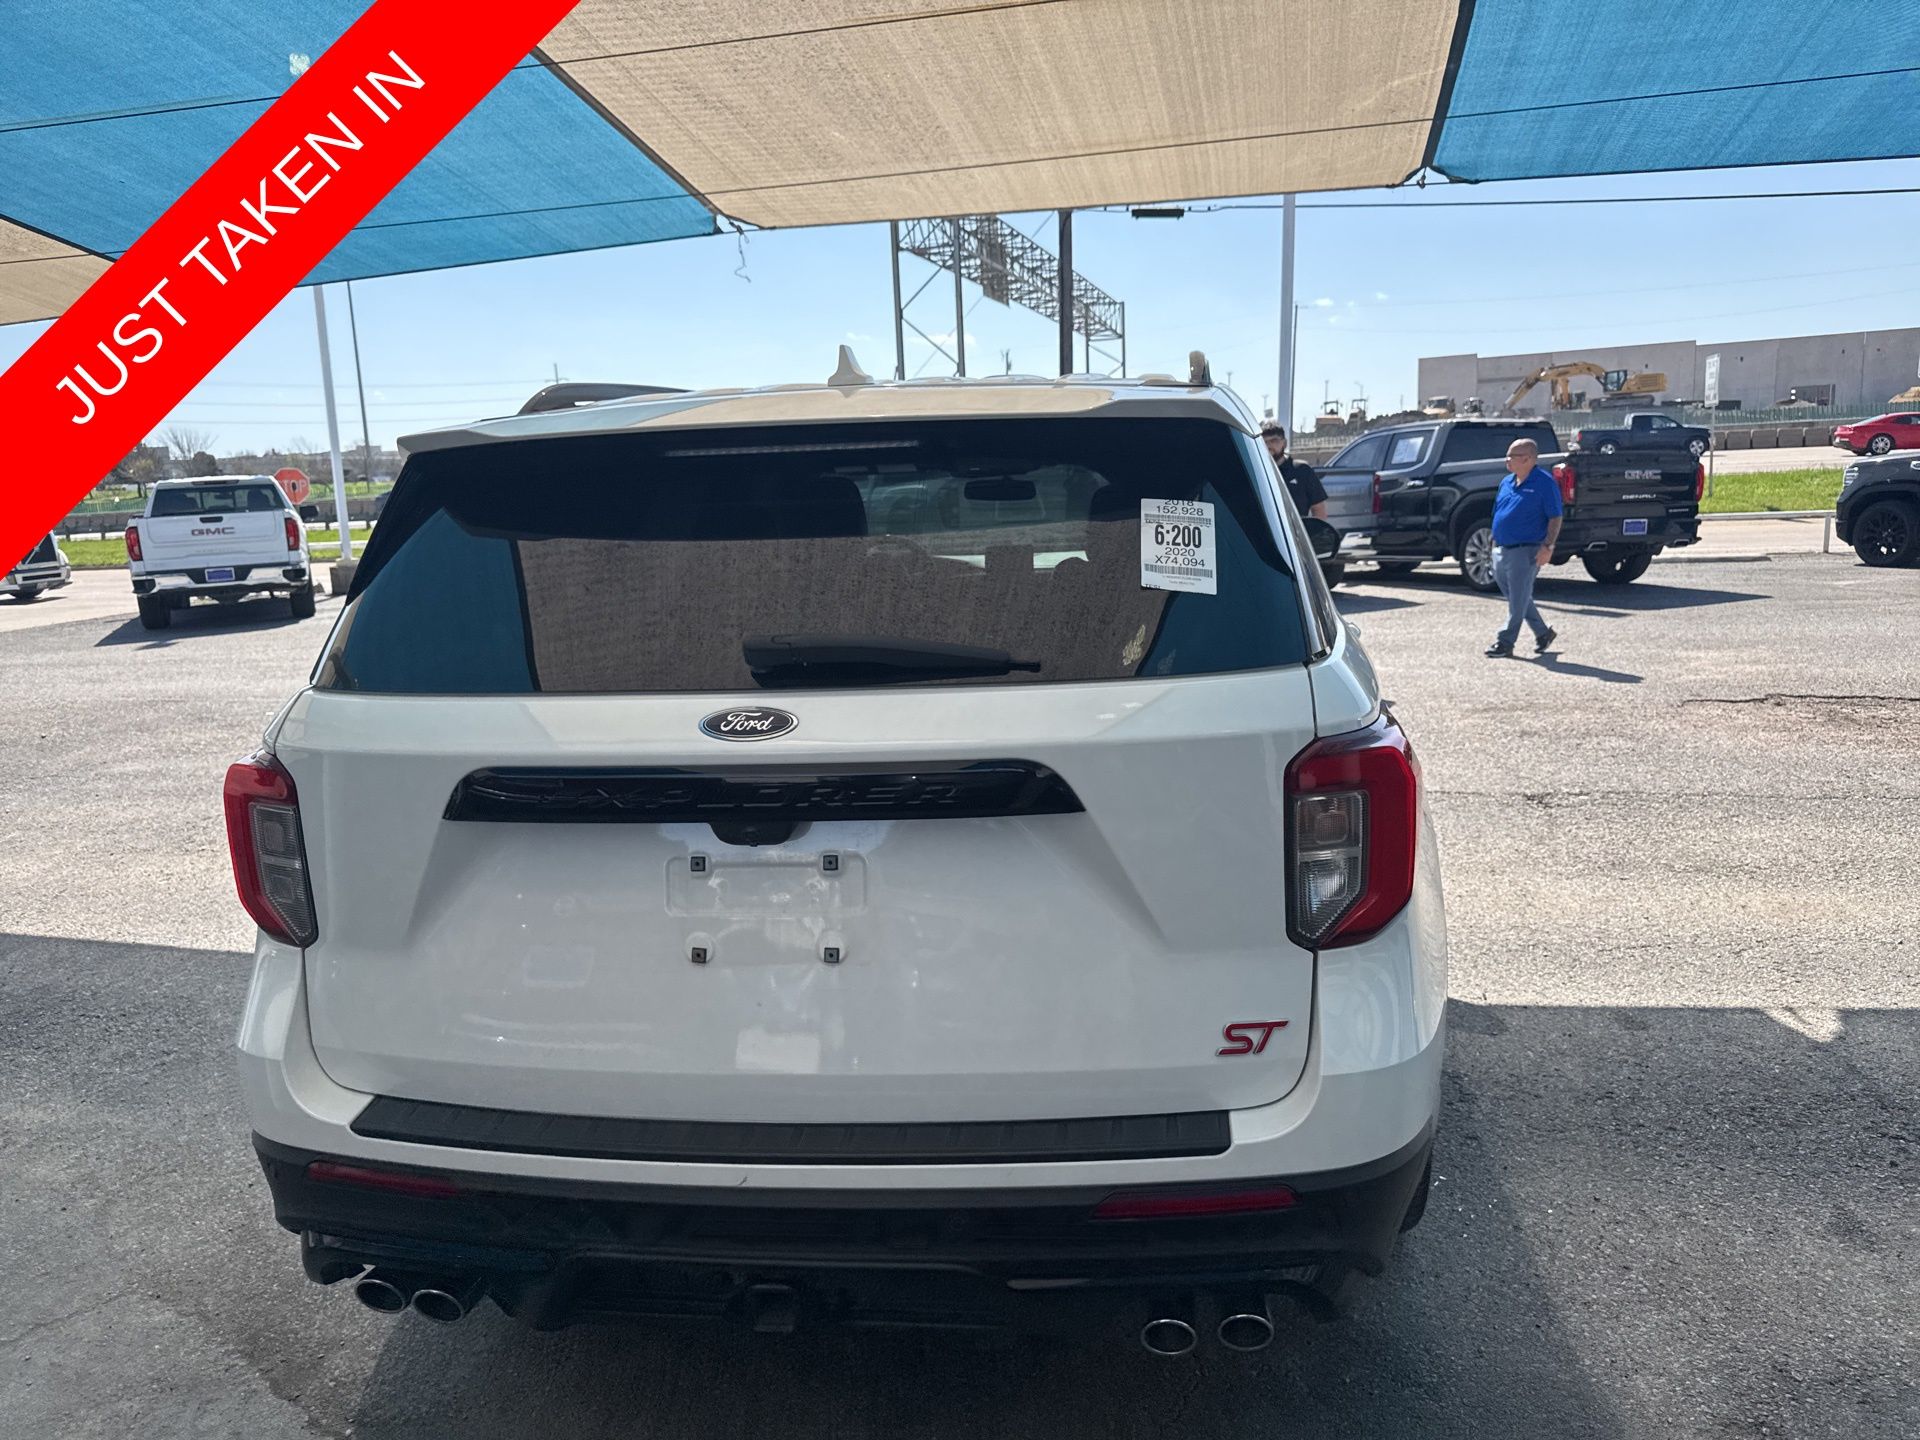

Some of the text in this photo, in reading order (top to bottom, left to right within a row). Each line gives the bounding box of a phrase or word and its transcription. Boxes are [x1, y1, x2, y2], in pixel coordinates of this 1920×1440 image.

[1624, 469, 1662, 480] GMC
[1156, 505, 1204, 516] 152,928
[191, 526, 236, 537] GMC
[1154, 524, 1201, 548] 6:200
[1164, 547, 1196, 557] 2020
[720, 711, 775, 732] Ford
[1217, 1020, 1289, 1056] ST
